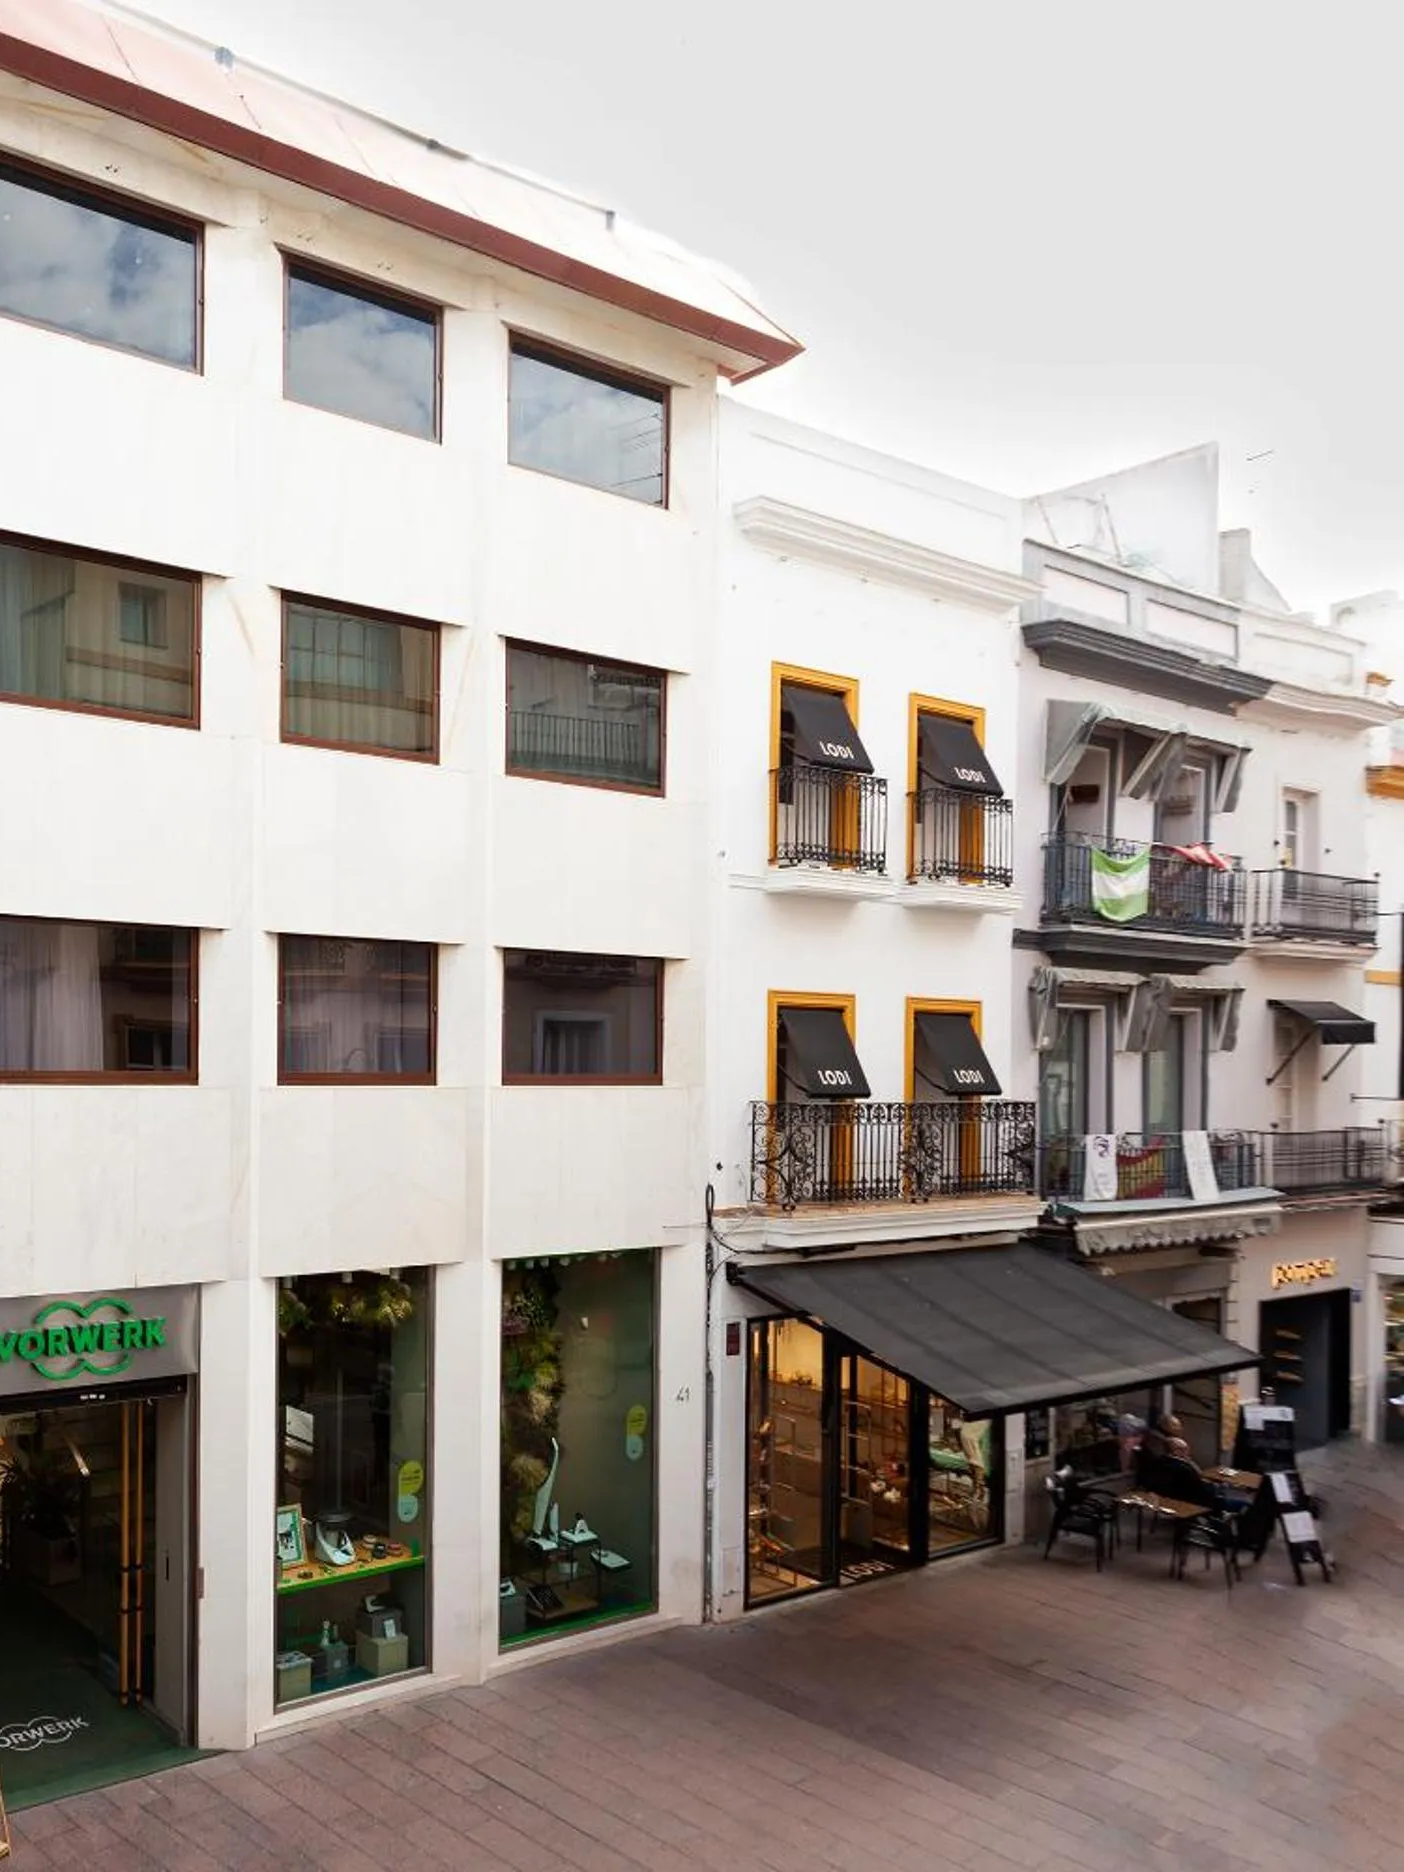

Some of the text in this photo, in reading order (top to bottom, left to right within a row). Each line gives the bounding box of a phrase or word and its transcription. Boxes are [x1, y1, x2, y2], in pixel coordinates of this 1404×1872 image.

[819, 741, 855, 759] LODI
[954, 767, 987, 783] LODI
[817, 1070, 853, 1085] LODI
[953, 1069, 986, 1084] LODI
